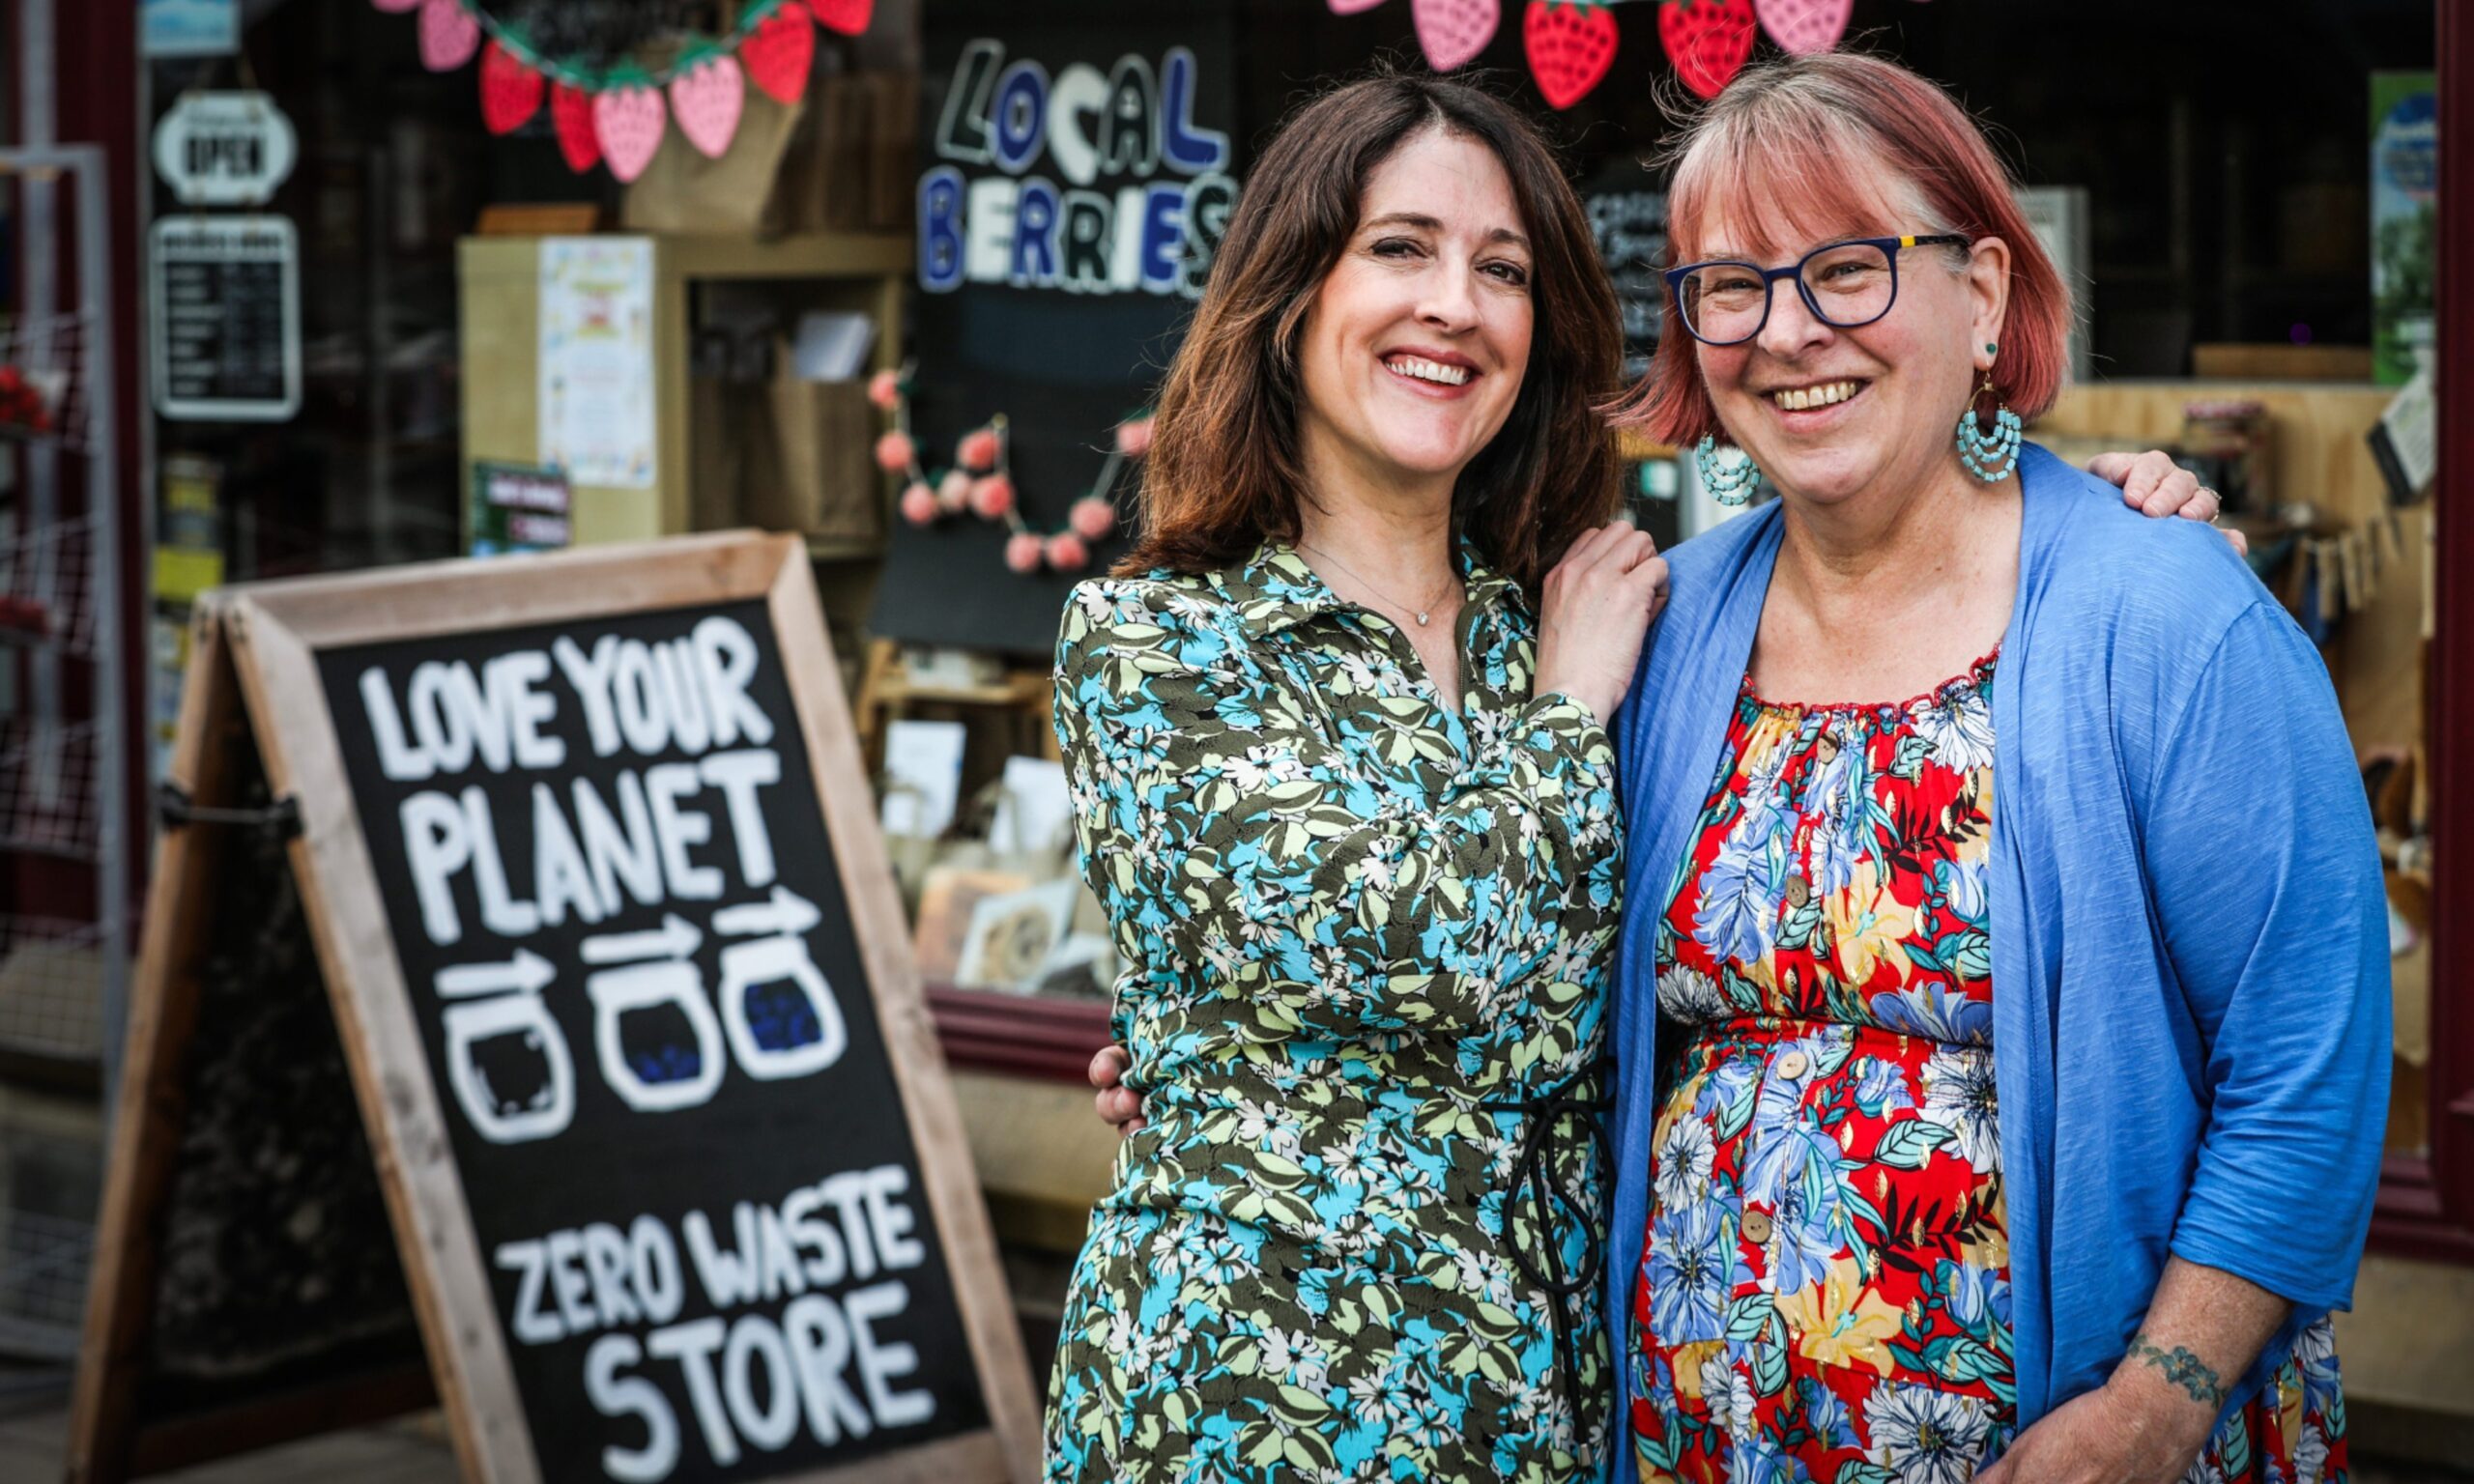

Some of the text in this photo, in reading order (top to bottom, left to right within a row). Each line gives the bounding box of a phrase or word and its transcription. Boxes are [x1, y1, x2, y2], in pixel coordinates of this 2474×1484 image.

[184, 134, 268, 179] OPEN
[935, 38, 1231, 186] LOCAL
[916, 164, 1240, 300] BERRIES
[359, 615, 774, 780] LOVE YOUR
[399, 748, 781, 946] PLANET
[495, 1163, 926, 1344] ZERO WASTE
[583, 1280, 937, 1483] STORE
